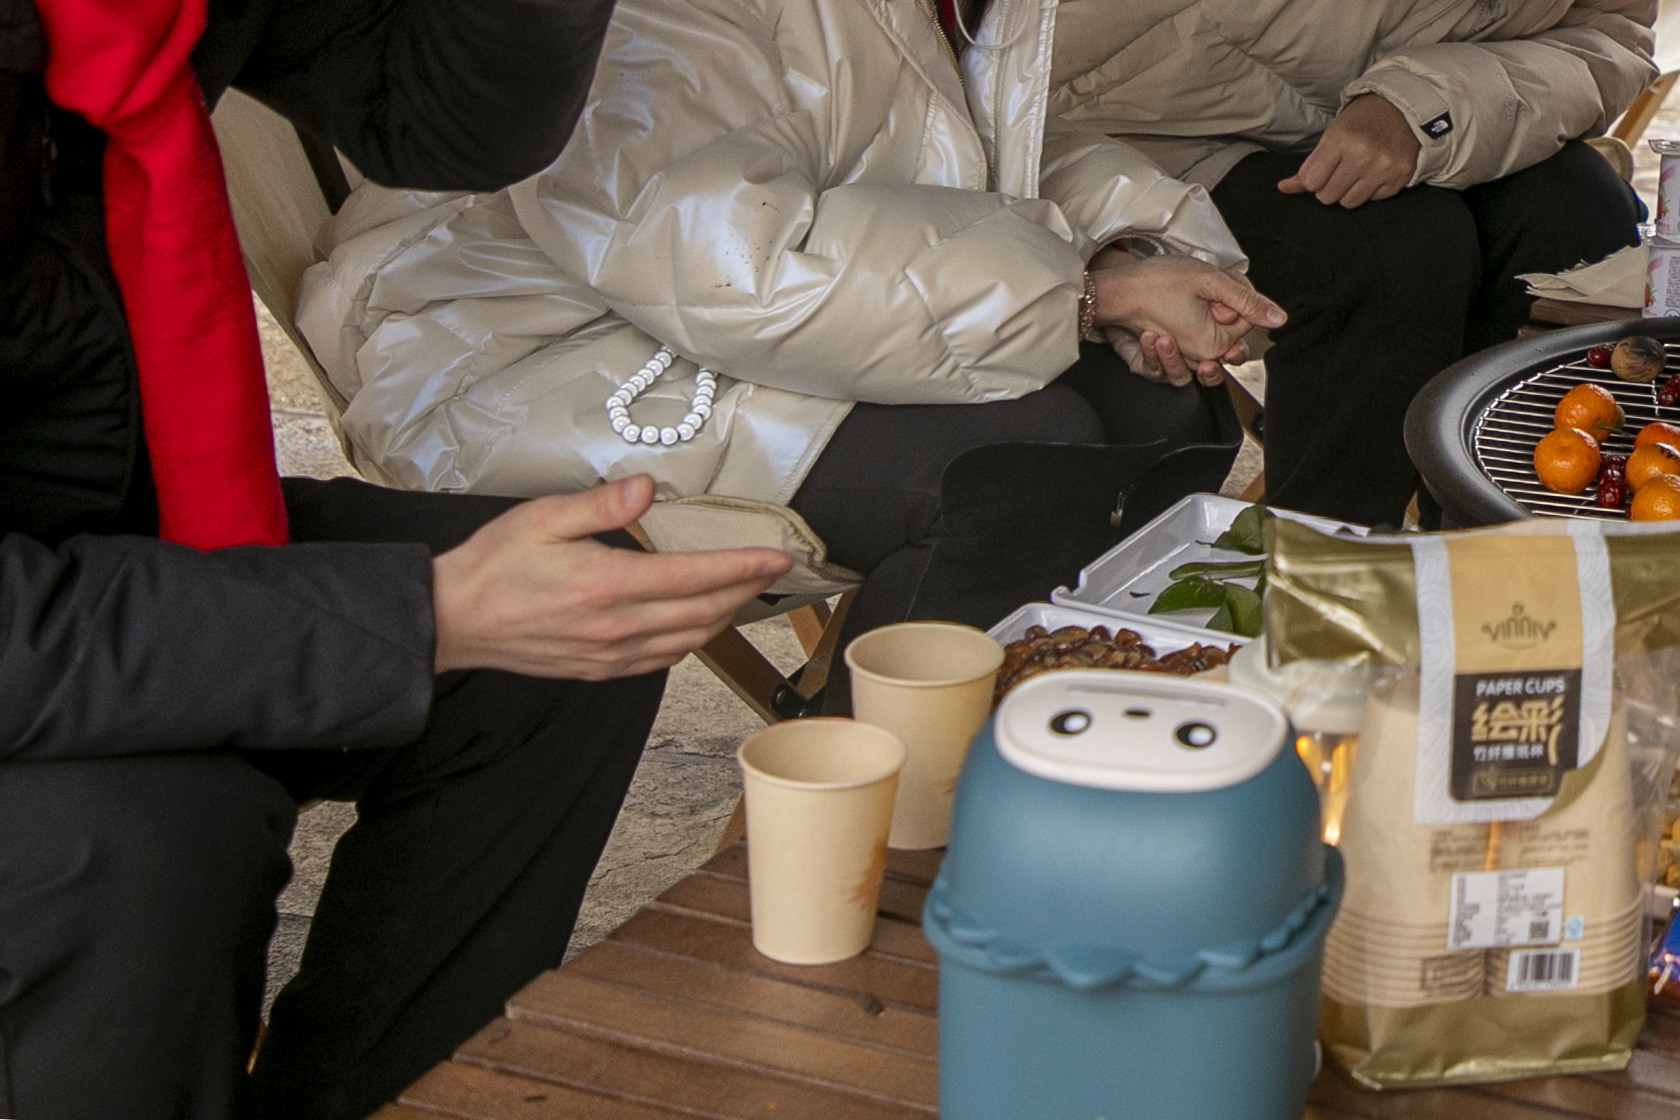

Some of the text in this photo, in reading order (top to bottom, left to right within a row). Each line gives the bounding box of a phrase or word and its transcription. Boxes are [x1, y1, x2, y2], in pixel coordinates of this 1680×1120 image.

[1476, 678, 1565, 697] PAPER CUPS
[1471, 695, 1566, 766] 绘彩
